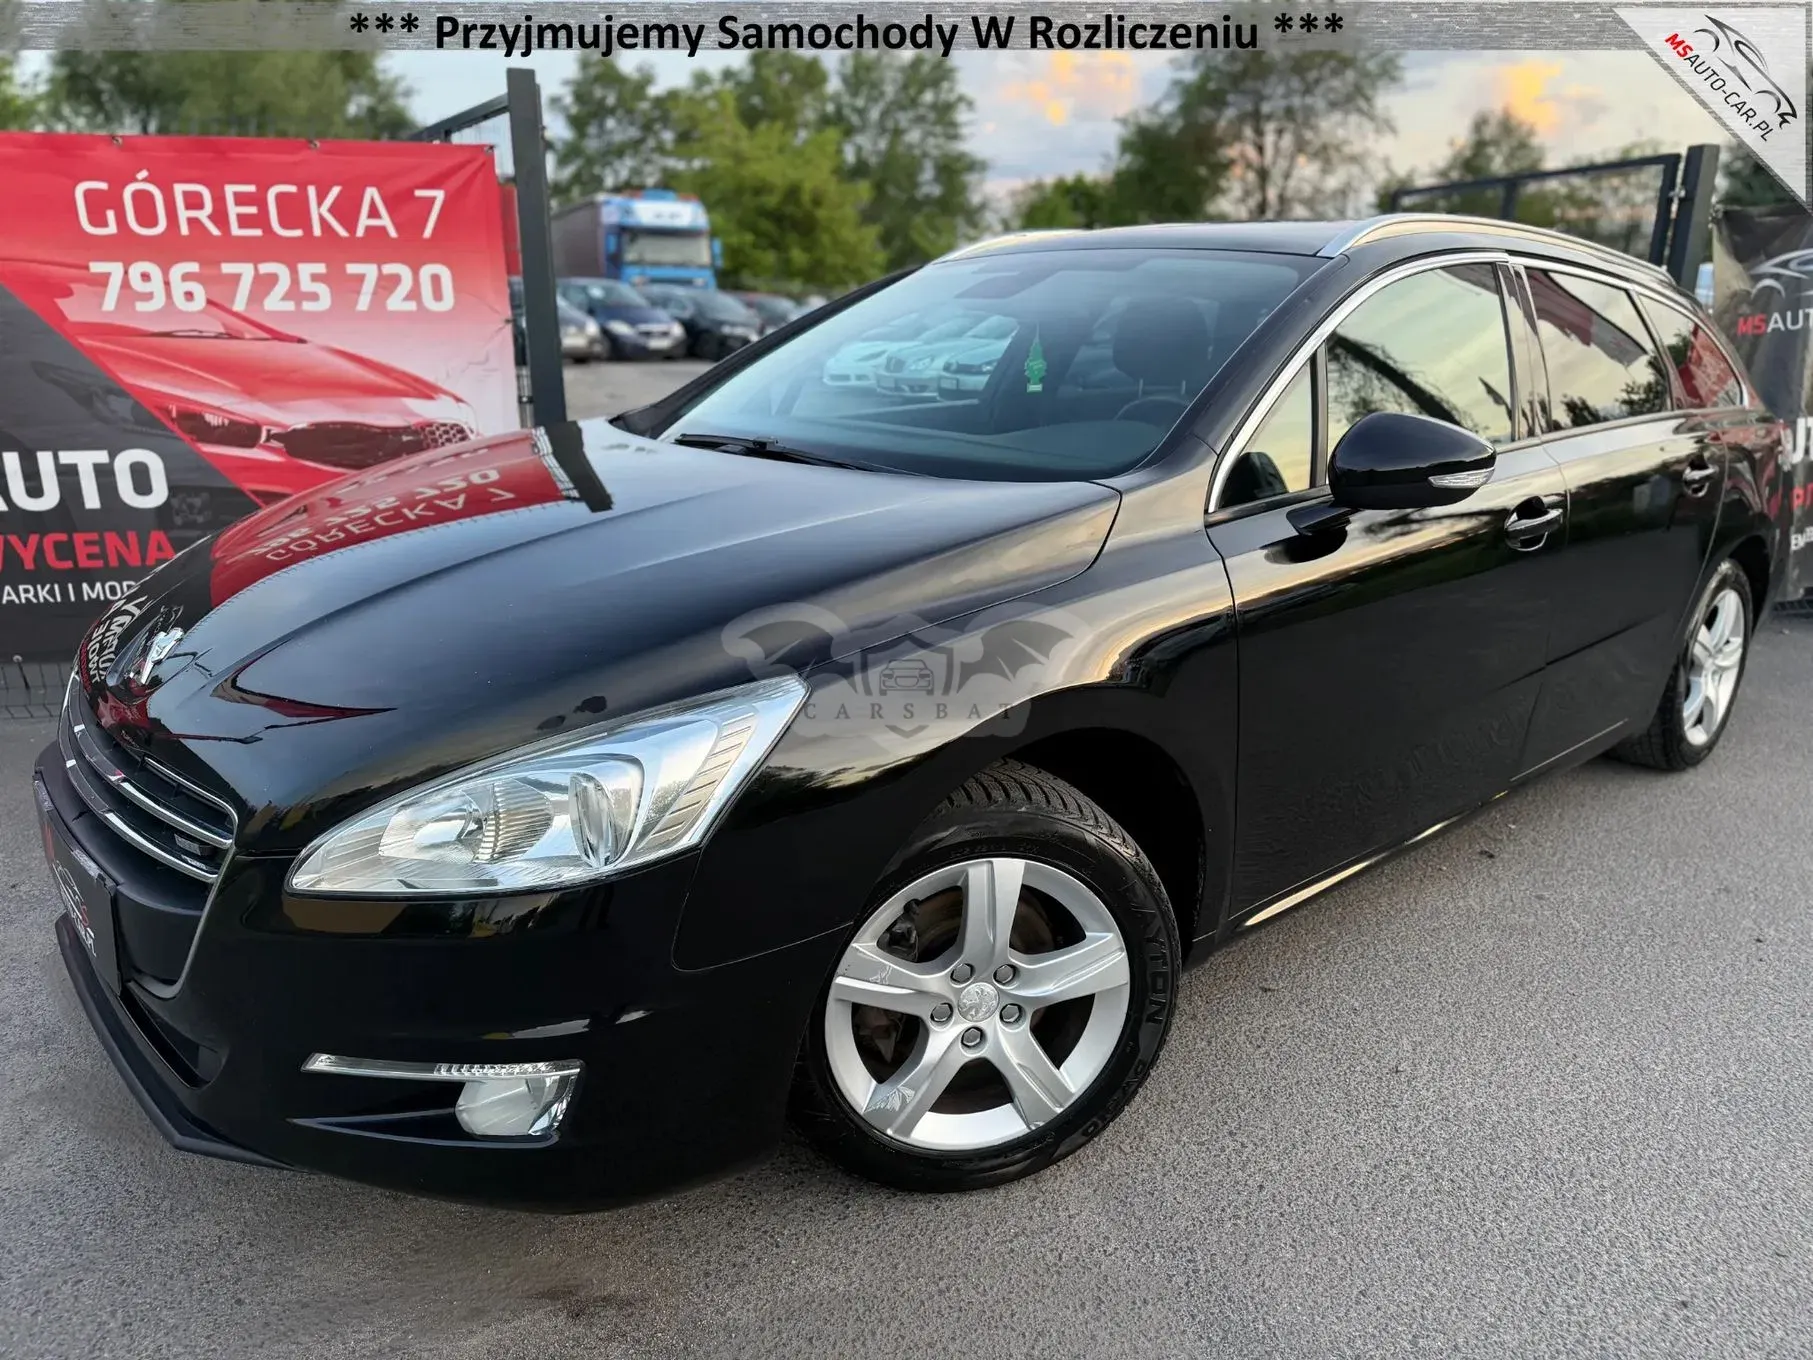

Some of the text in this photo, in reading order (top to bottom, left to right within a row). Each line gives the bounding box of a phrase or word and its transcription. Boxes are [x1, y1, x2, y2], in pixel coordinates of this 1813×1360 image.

[74, 168, 446, 239] GÓRECKA 7
[88, 261, 455, 312] 796 725 720
[0, 448, 169, 512] UTO
[0, 529, 177, 573] YCENA
[67, 582, 76, 602] I
